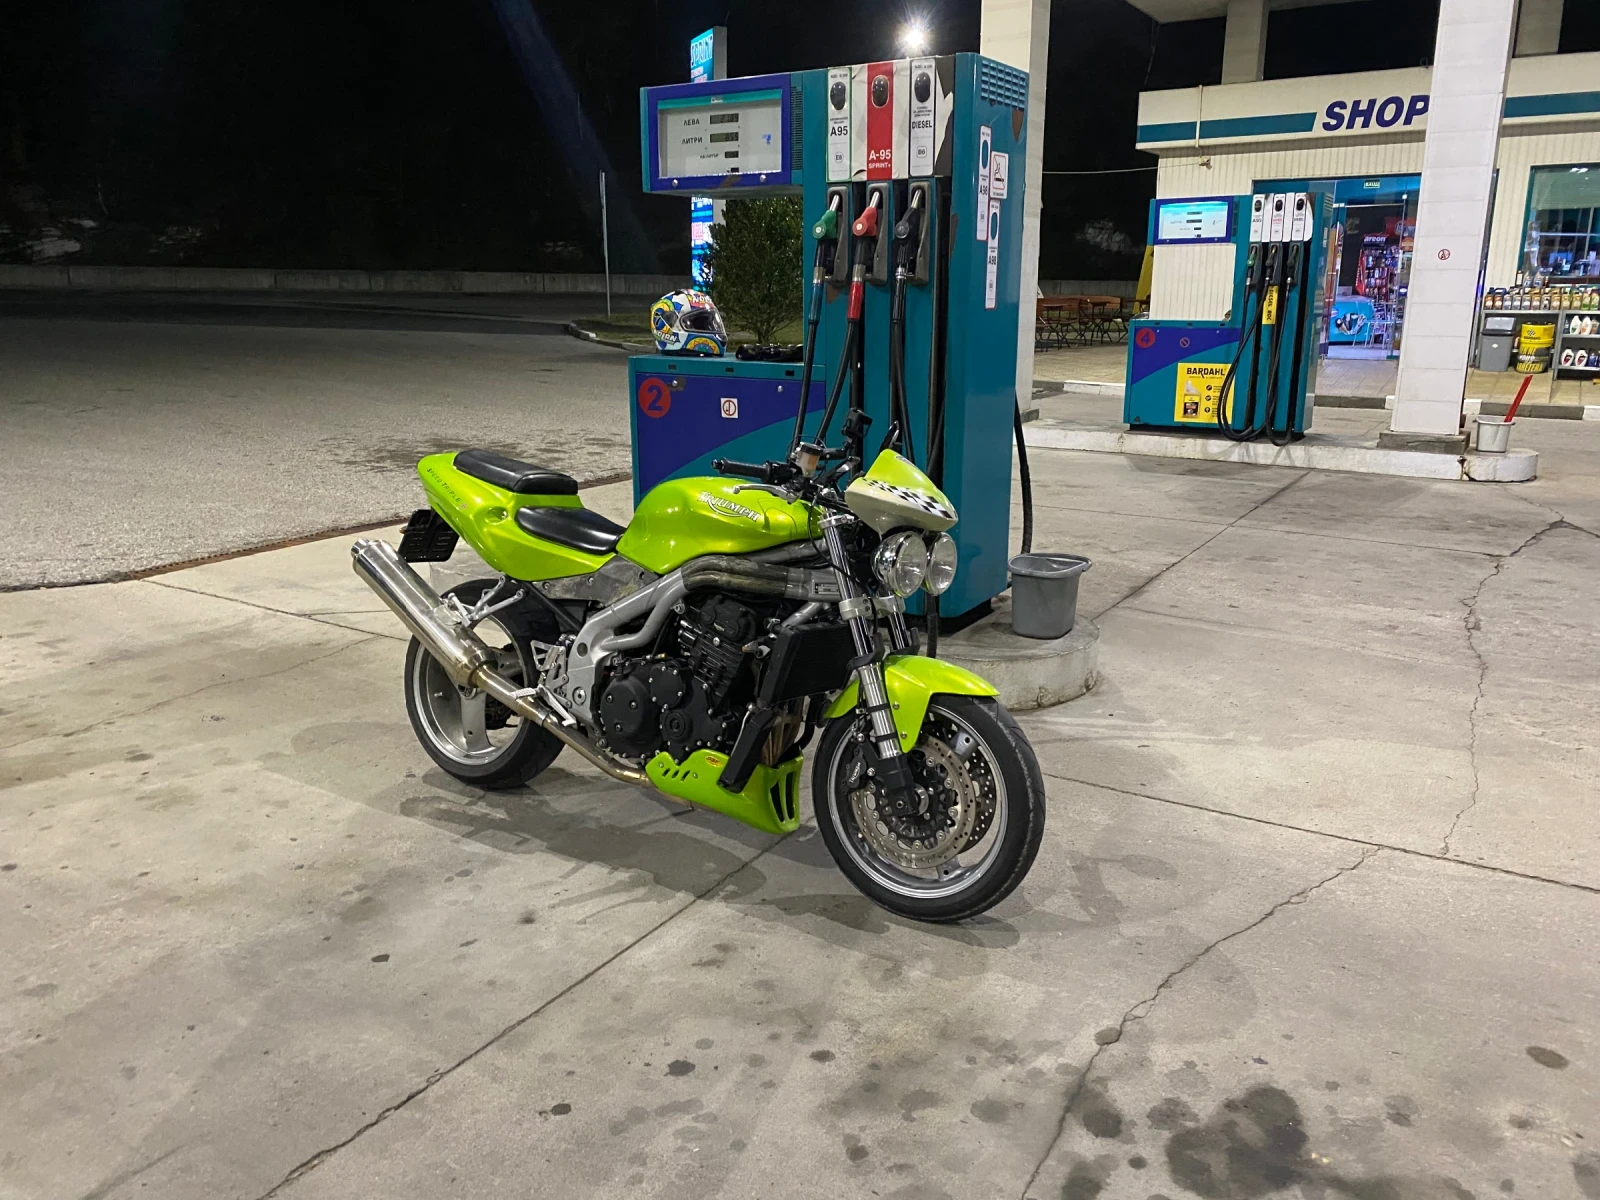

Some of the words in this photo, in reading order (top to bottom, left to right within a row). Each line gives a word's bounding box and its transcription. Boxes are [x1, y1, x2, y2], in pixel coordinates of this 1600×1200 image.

[1322, 95, 1430, 131] SHOP
[830, 126, 848, 136] A95
[911, 120, 932, 129] DIESEL
[868, 149, 891, 160] A-95
[1140, 332, 1150, 346] 4
[1186, 367, 1226, 378] BARDAHL
[647, 385, 663, 412] 2
[426, 468, 443, 483] SPEED
[441, 482, 462, 503] TRIPLE
[697, 490, 762, 522] TRIUMPH
